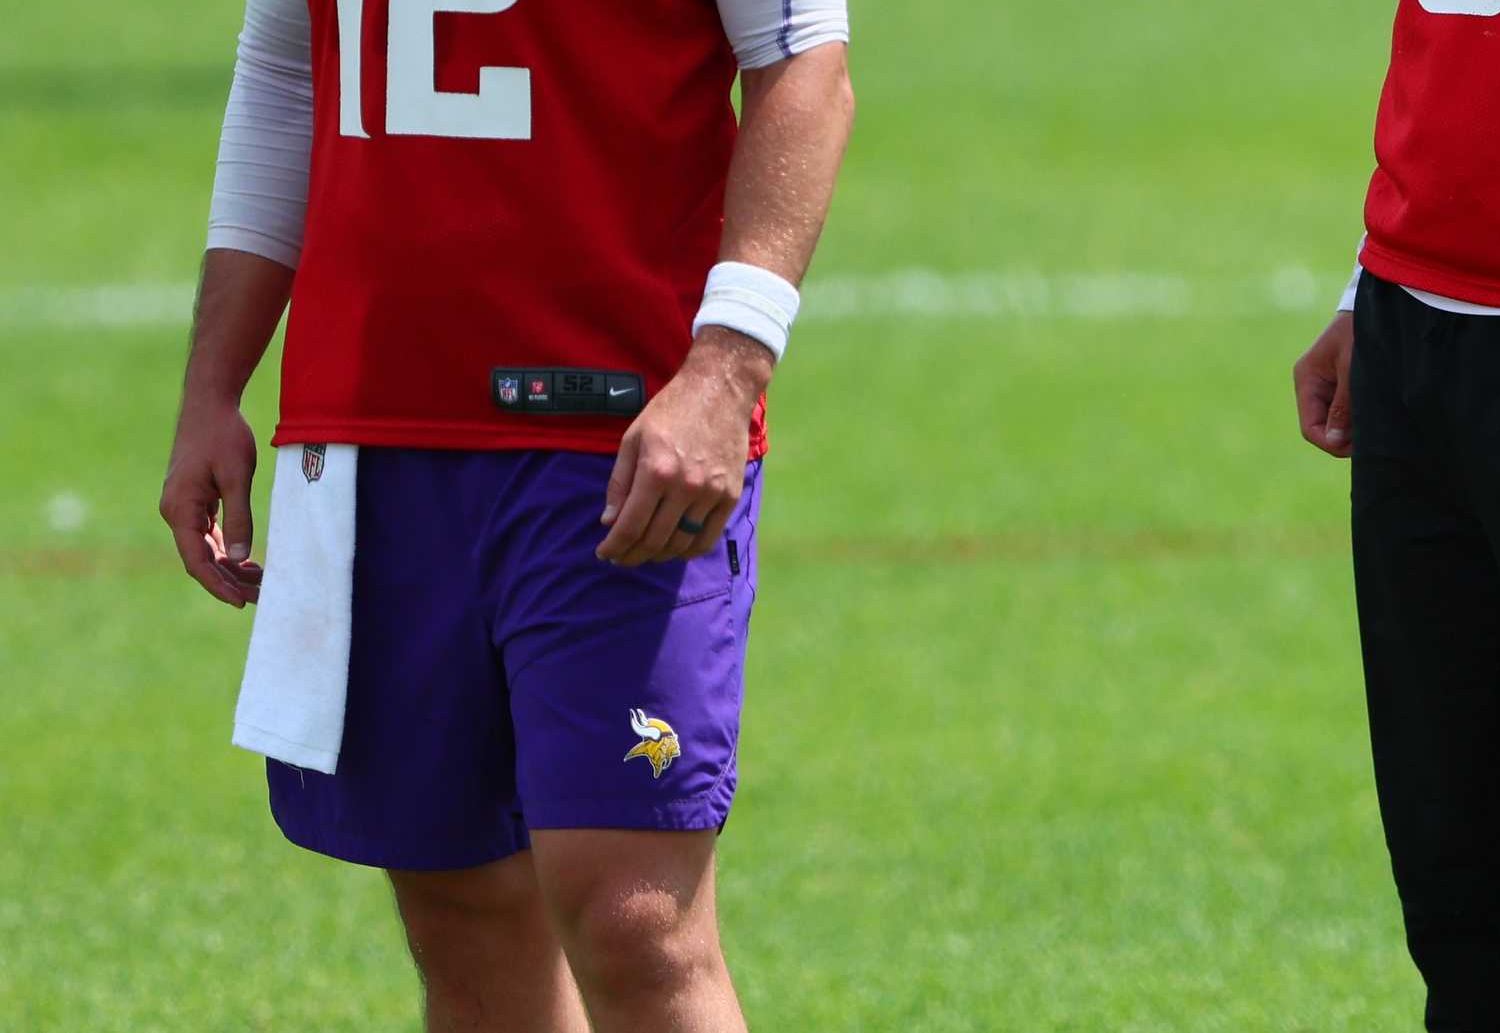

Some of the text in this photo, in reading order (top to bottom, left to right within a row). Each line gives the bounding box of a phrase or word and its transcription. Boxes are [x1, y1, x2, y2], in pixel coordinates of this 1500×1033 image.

[563, 375, 594, 392] 52
[501, 388, 517, 402] NFL
[304, 450, 321, 478] NFL
